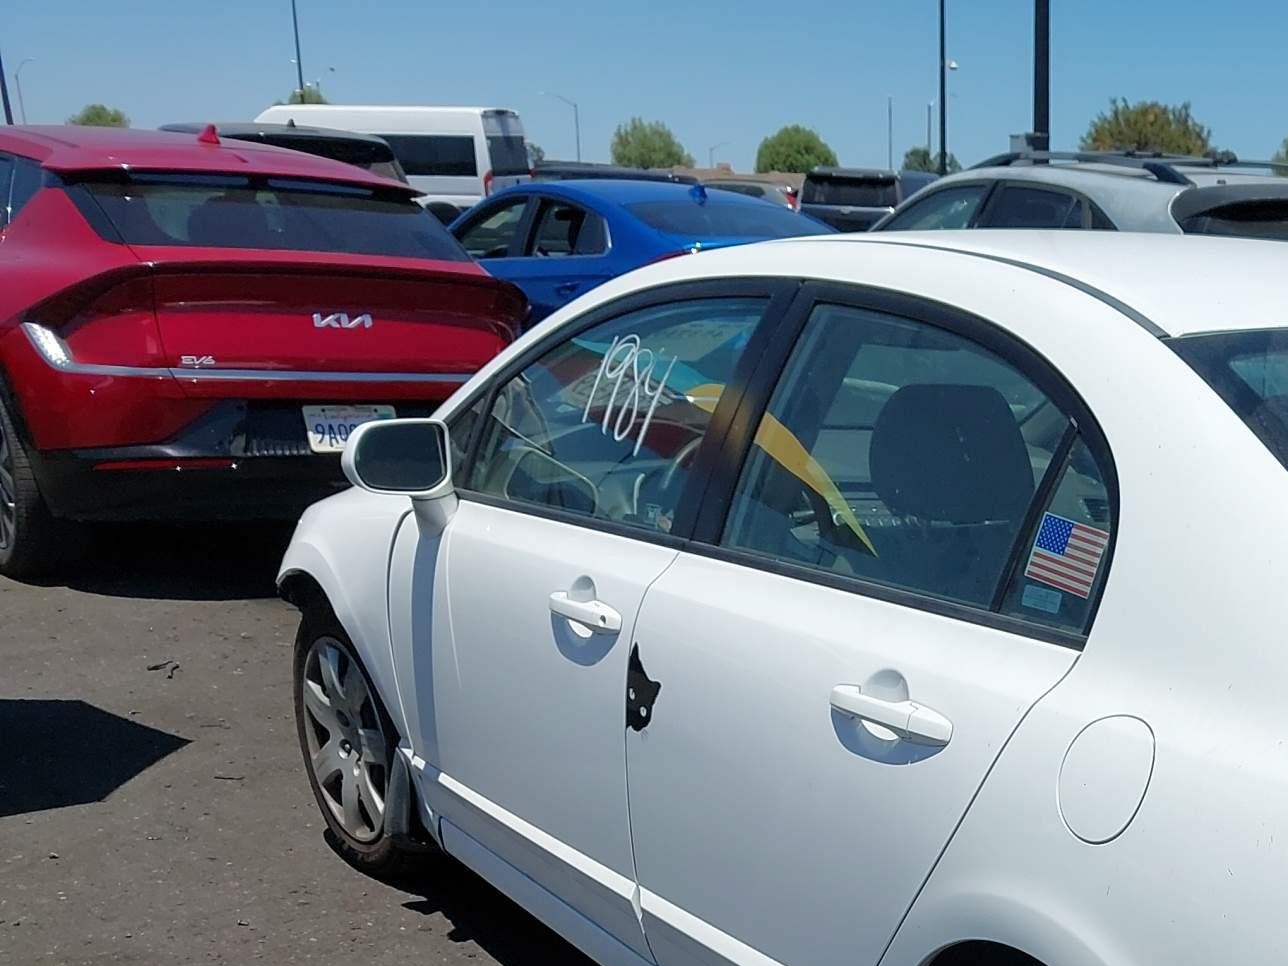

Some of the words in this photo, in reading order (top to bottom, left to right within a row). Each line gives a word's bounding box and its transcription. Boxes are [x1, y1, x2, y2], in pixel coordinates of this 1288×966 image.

[312, 312, 373, 329] KIA
[180, 355, 216, 365] EV6
[582, 334, 678, 457] 1984
